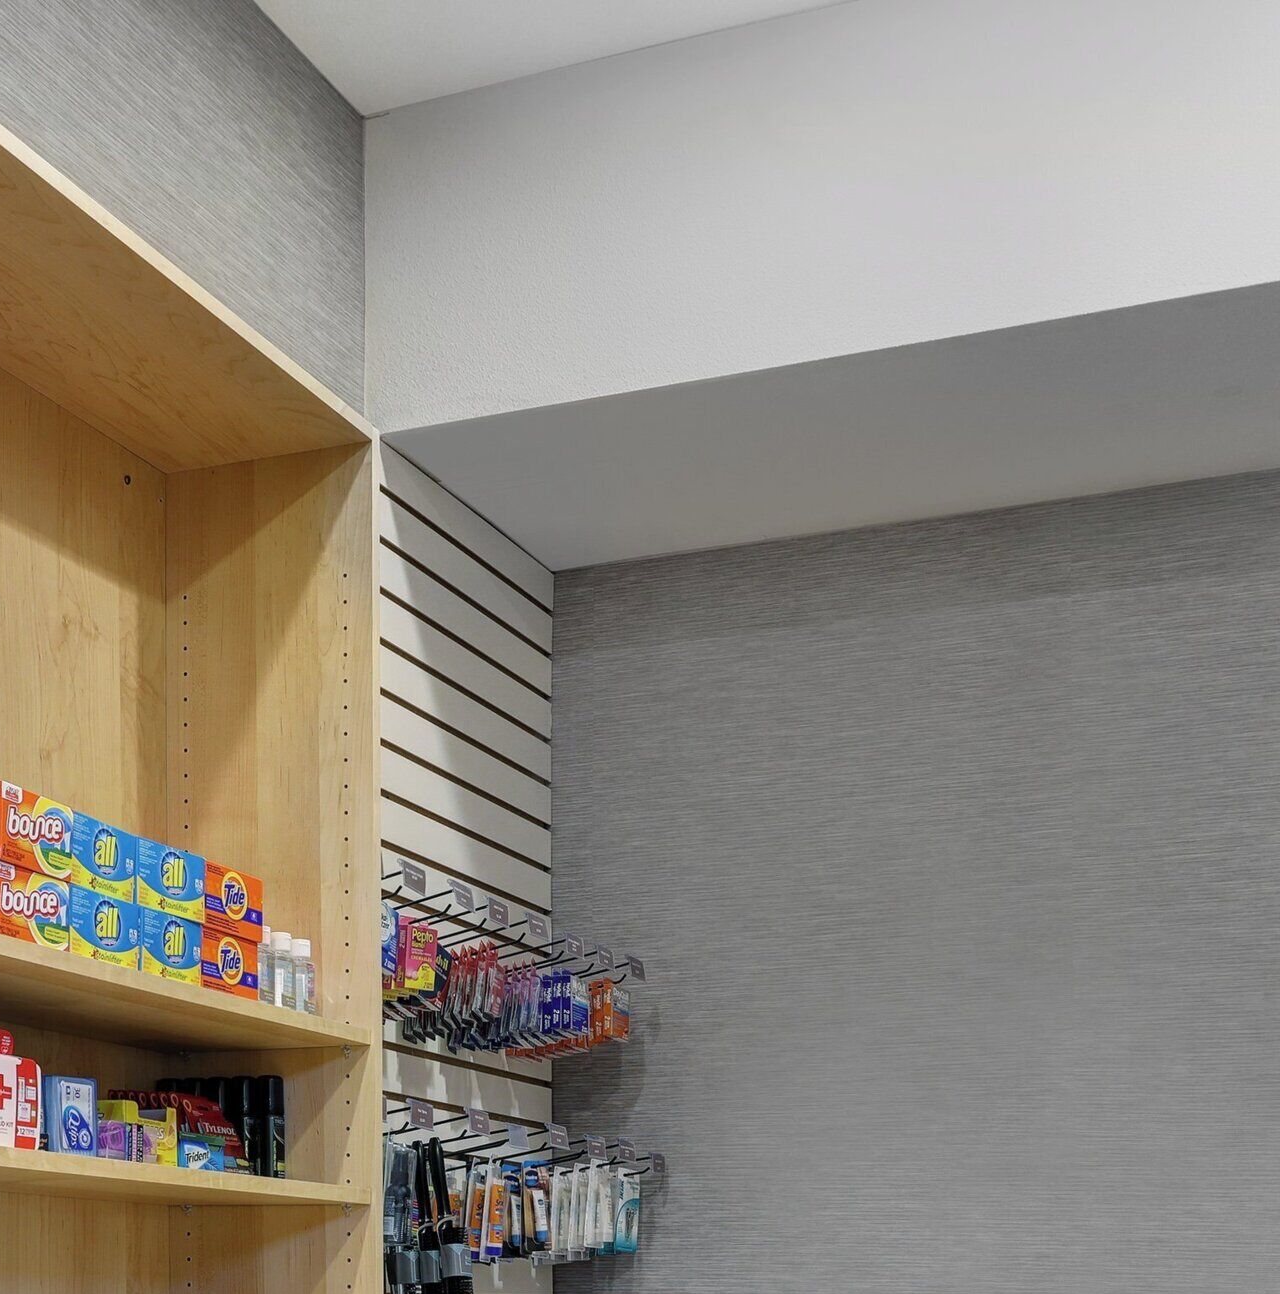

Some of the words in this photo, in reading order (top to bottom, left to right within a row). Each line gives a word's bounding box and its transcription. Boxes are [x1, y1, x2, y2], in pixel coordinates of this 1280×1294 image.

[7, 806, 65, 845] bounce
[94, 835, 117, 867] all
[161, 858, 184, 889] all
[1, 882, 60, 919] bounce
[224, 883, 245, 907] Tide
[95, 907, 118, 939] all
[411, 928, 433, 942] Pepto
[163, 926, 184, 957] all
[220, 950, 241, 972] Tide
[74, 1087, 80, 1099] 30
[203, 1122, 236, 1135] TYLENOL
[185, 1150, 210, 1165] Trident
